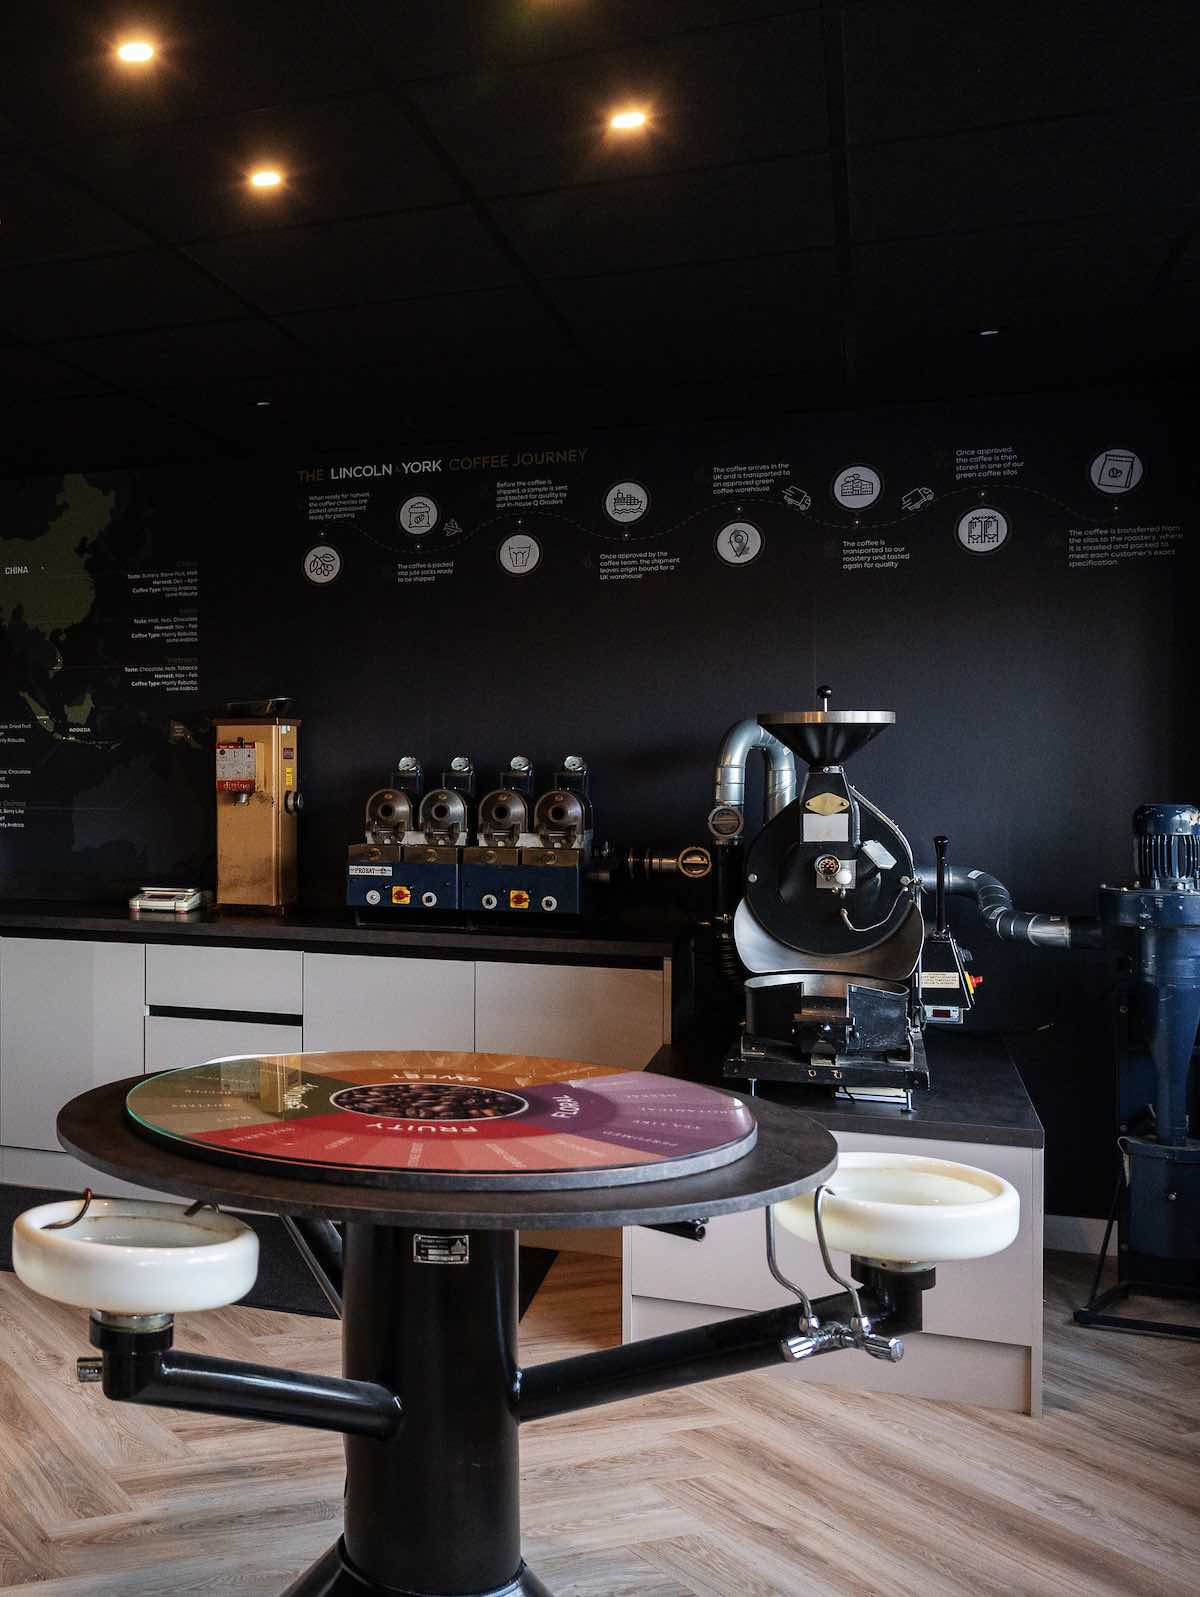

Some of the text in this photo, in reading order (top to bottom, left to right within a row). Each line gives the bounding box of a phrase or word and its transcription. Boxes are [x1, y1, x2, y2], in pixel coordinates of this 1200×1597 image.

[297, 449, 588, 481] THE LINCOLN YORK COFFEE JOURNEY
[856, 539, 879, 547] coffee
[4, 565, 29, 575] CHINA
[392, 1071, 482, 1083] SWEET
[552, 1094, 581, 1120] FLORAL
[366, 1122, 479, 1134] FRUITY
